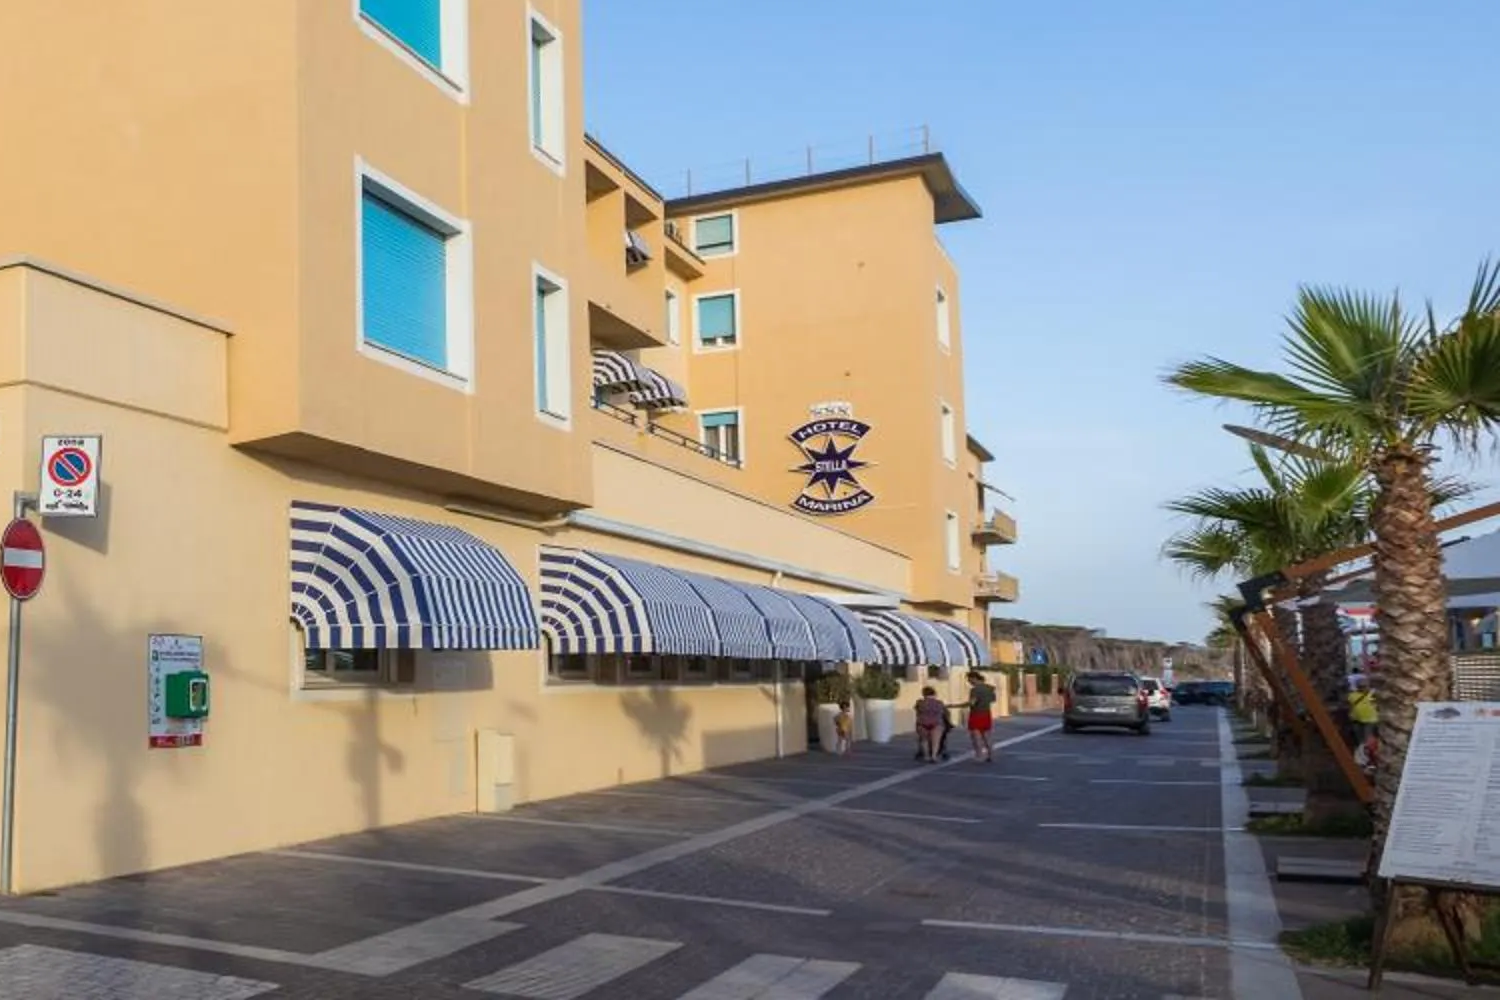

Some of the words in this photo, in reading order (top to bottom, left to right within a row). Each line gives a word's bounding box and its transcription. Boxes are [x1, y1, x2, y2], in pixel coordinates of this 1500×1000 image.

[799, 422, 861, 439] HOTEL
[815, 459, 846, 472] STELLA
[799, 494, 869, 511] MARINA
